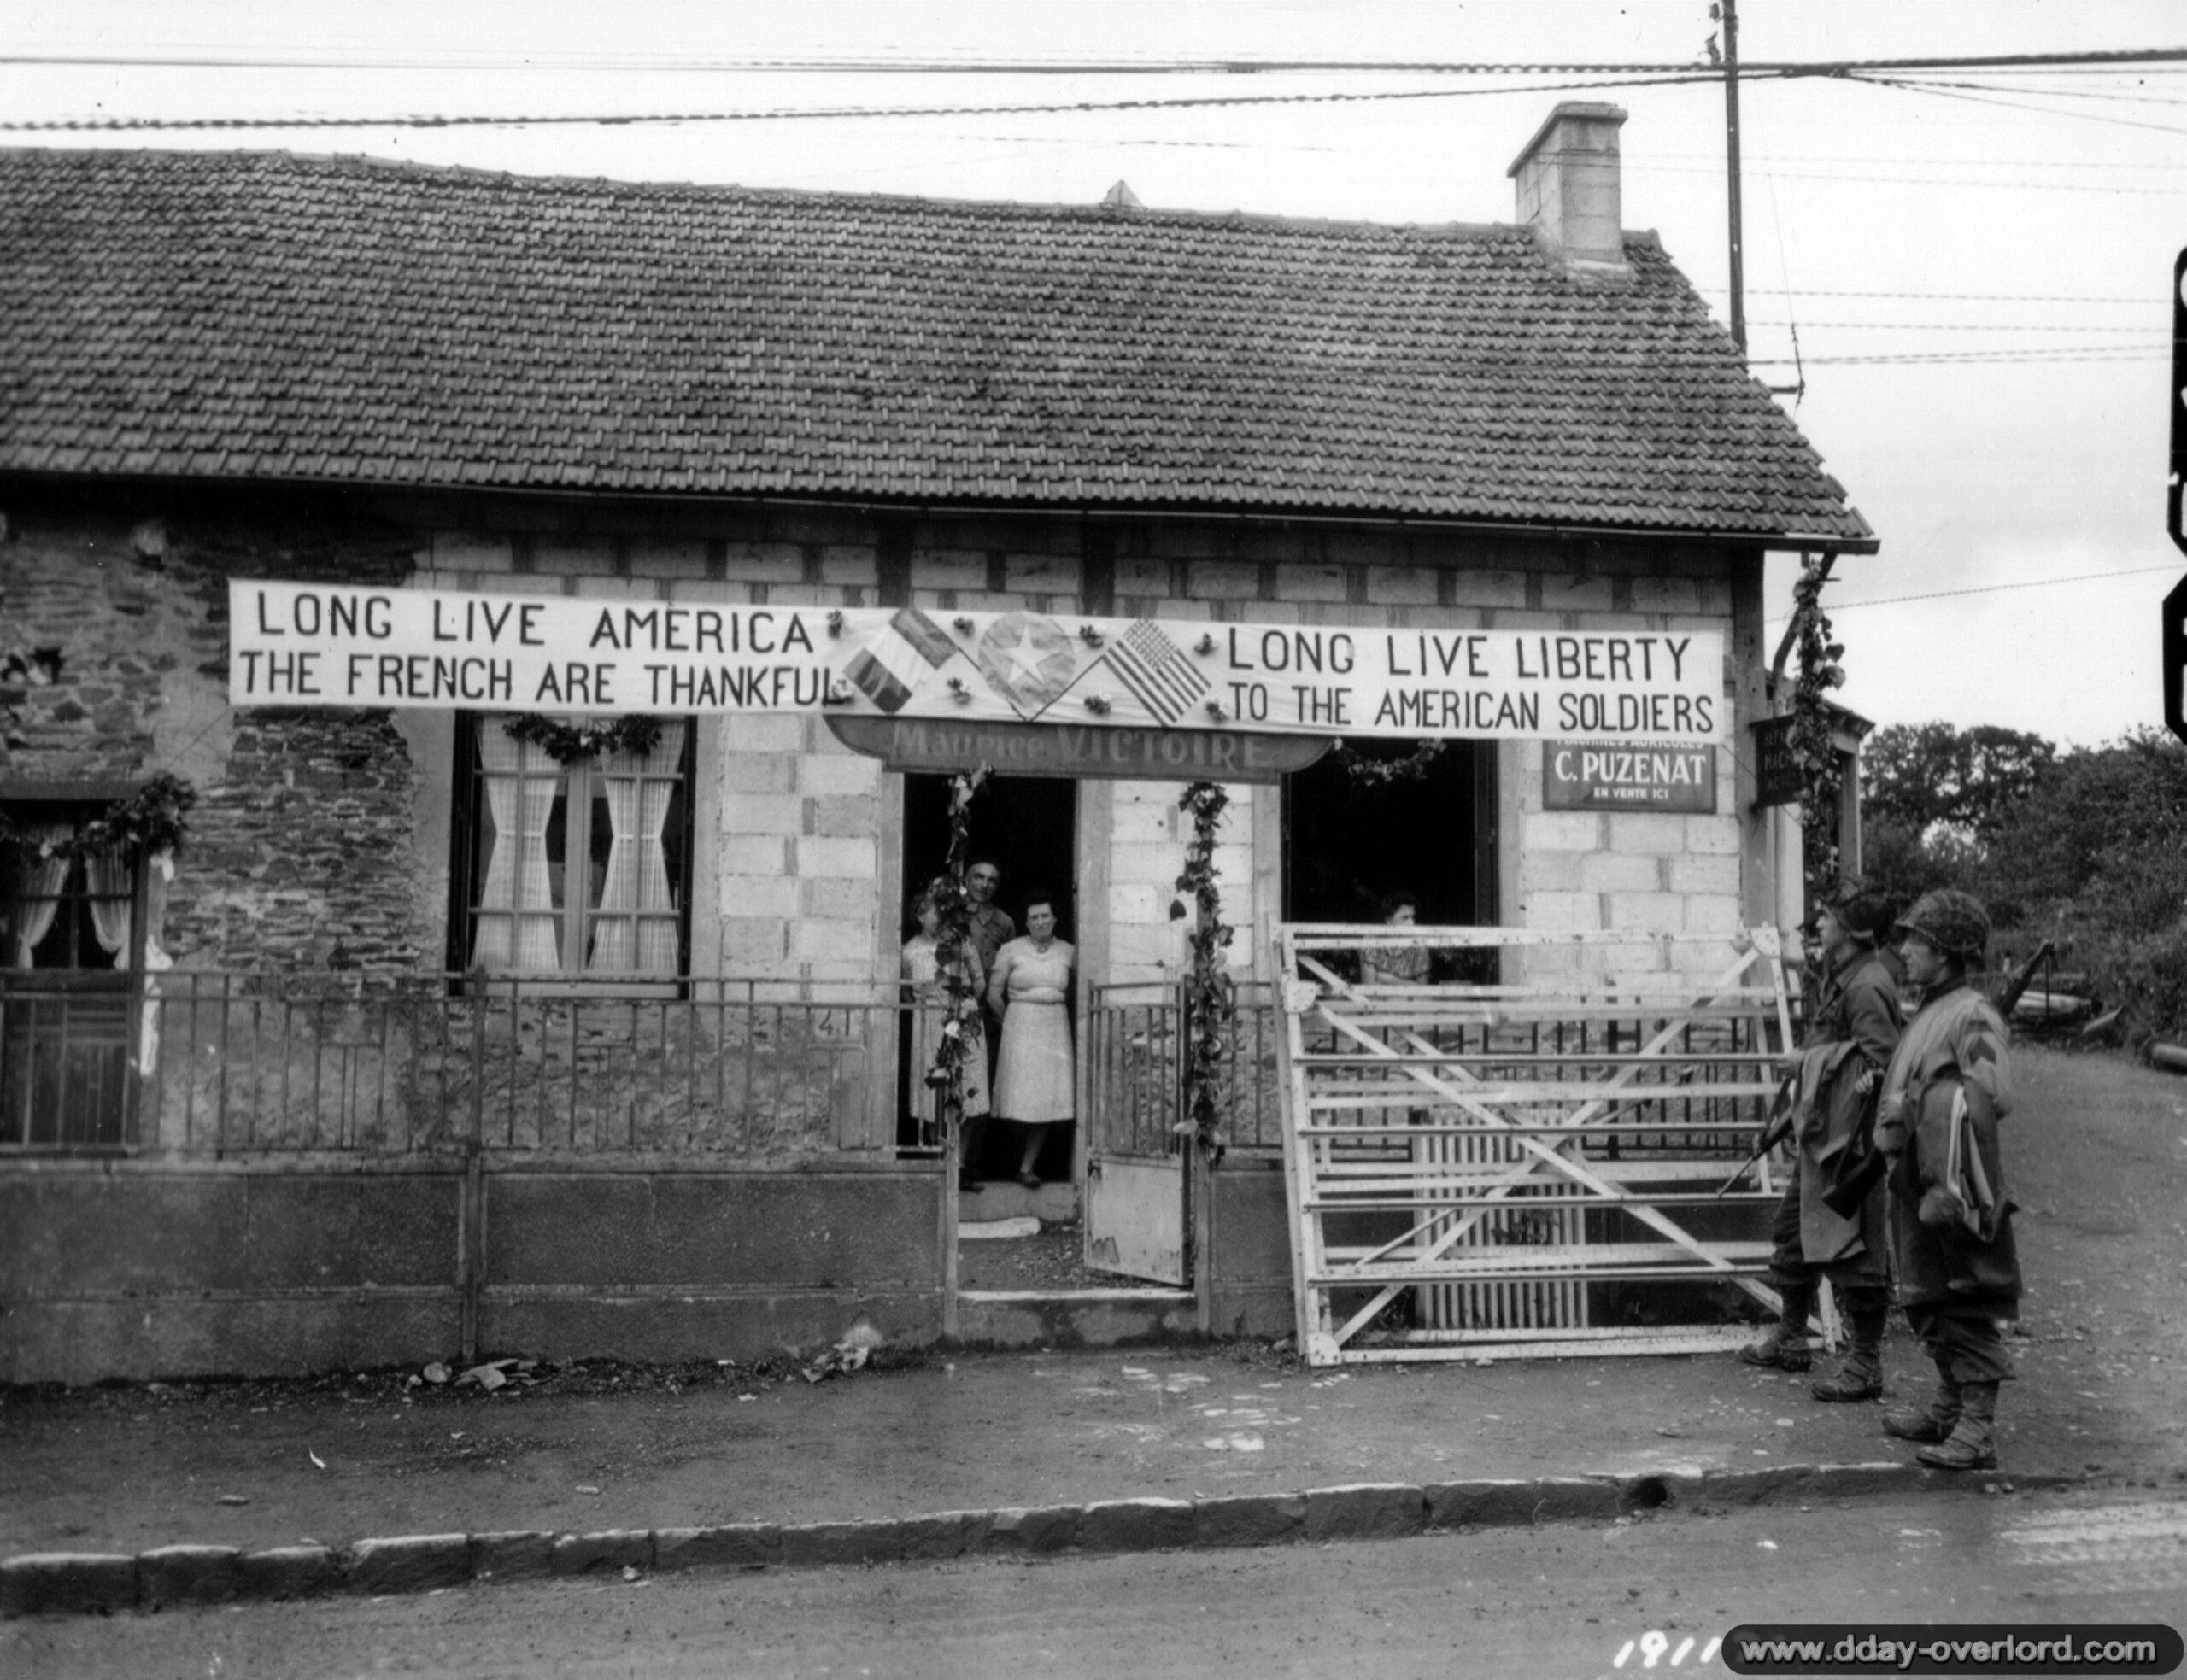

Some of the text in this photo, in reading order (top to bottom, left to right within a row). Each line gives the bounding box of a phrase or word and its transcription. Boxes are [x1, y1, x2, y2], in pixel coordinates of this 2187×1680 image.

[258, 591, 814, 653] LONG LIVE AMERICA
[1228, 627, 1691, 681] LONG LIVE LIBERTY
[239, 650, 1714, 733] THE FRENCH ARE THANKFUL TO THE AMERICAN SOLDIERS
[1057, 725, 1276, 771] VICTOIRE
[1582, 751, 1707, 785] PUZENAT
[1593, 787, 1669, 800] EN VENTE ICI
